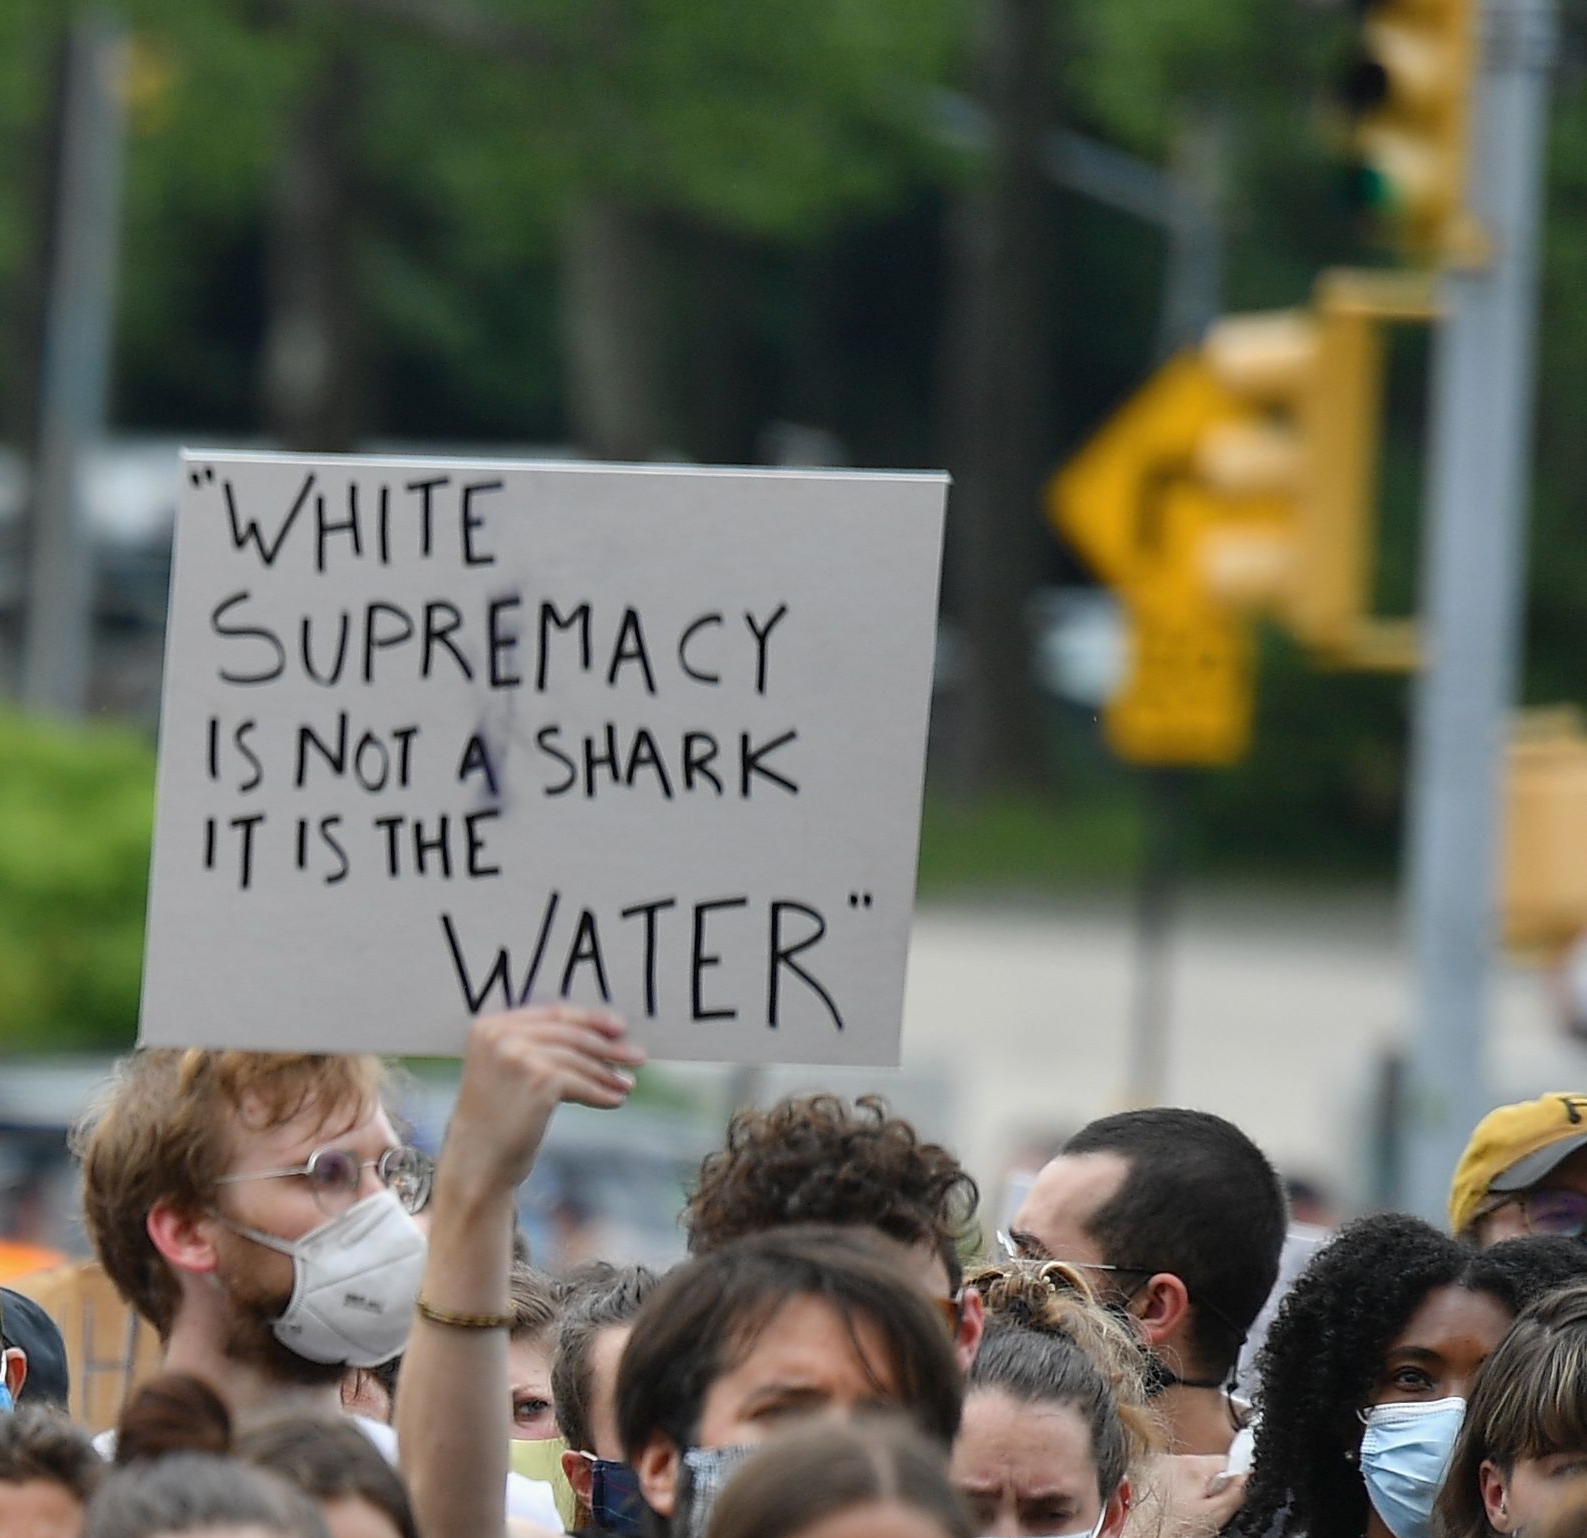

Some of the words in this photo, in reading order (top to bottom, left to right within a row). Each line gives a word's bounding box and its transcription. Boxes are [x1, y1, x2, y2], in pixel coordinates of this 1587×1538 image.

[191, 468, 503, 573] "WHITE
[212, 592, 787, 695] SUPREMACY
[208, 718, 261, 792] IS
[296, 711, 418, 792] NOT
[458, 732, 500, 799] A
[536, 722, 799, 800] SHARK
[205, 814, 264, 889] IT
[297, 815, 348, 884] IS
[374, 806, 502, 879] THE
[441, 892, 872, 1032] WATER"
